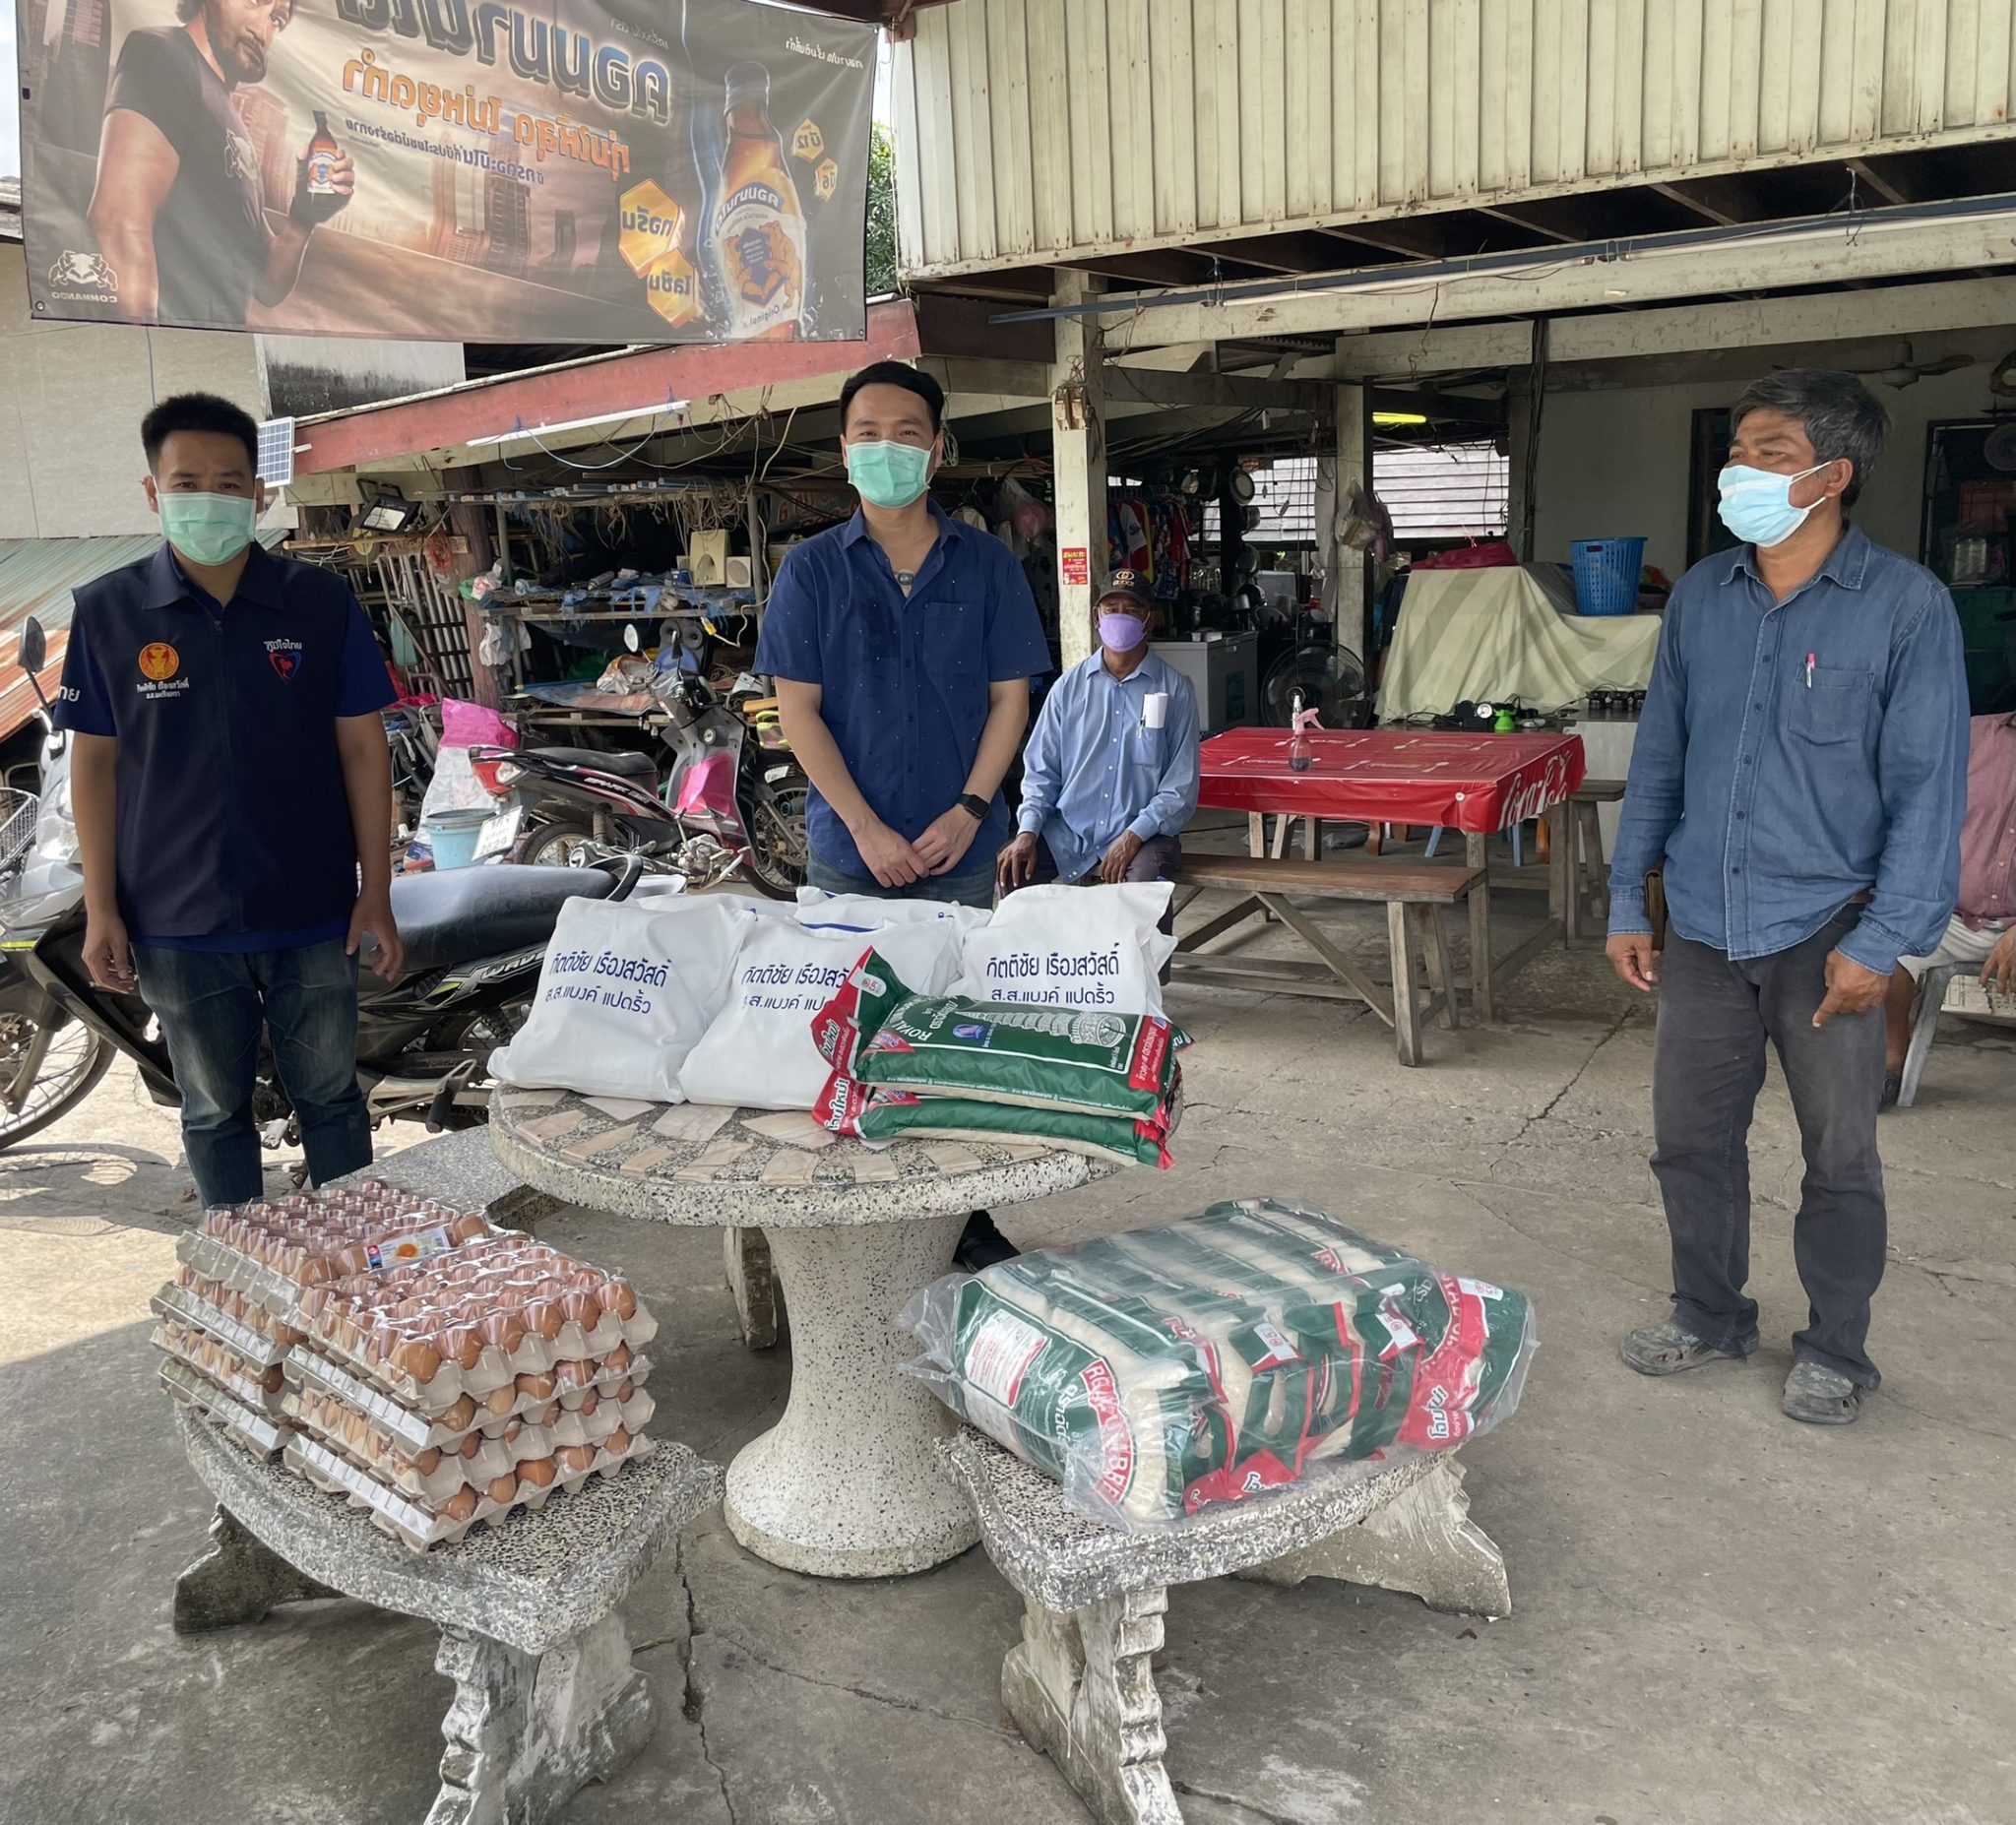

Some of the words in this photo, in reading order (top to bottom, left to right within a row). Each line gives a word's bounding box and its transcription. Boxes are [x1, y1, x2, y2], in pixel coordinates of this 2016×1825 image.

[549, 950, 593, 976] กิตติชัย
[593, 950, 673, 988] เรืองสวัสดิ์
[986, 952, 1040, 978] กิตติชัย
[1045, 941, 1120, 977] เรืองสวัสดิ์
[741, 963, 794, 985] กิตติชัย
[601, 989, 652, 1015] แปดริ้ว
[991, 985, 1061, 1003] ส.ส.แบงค์
[1065, 981, 1115, 1005] แปดริ้ว
[891, 1020, 933, 1041] ROYAL
